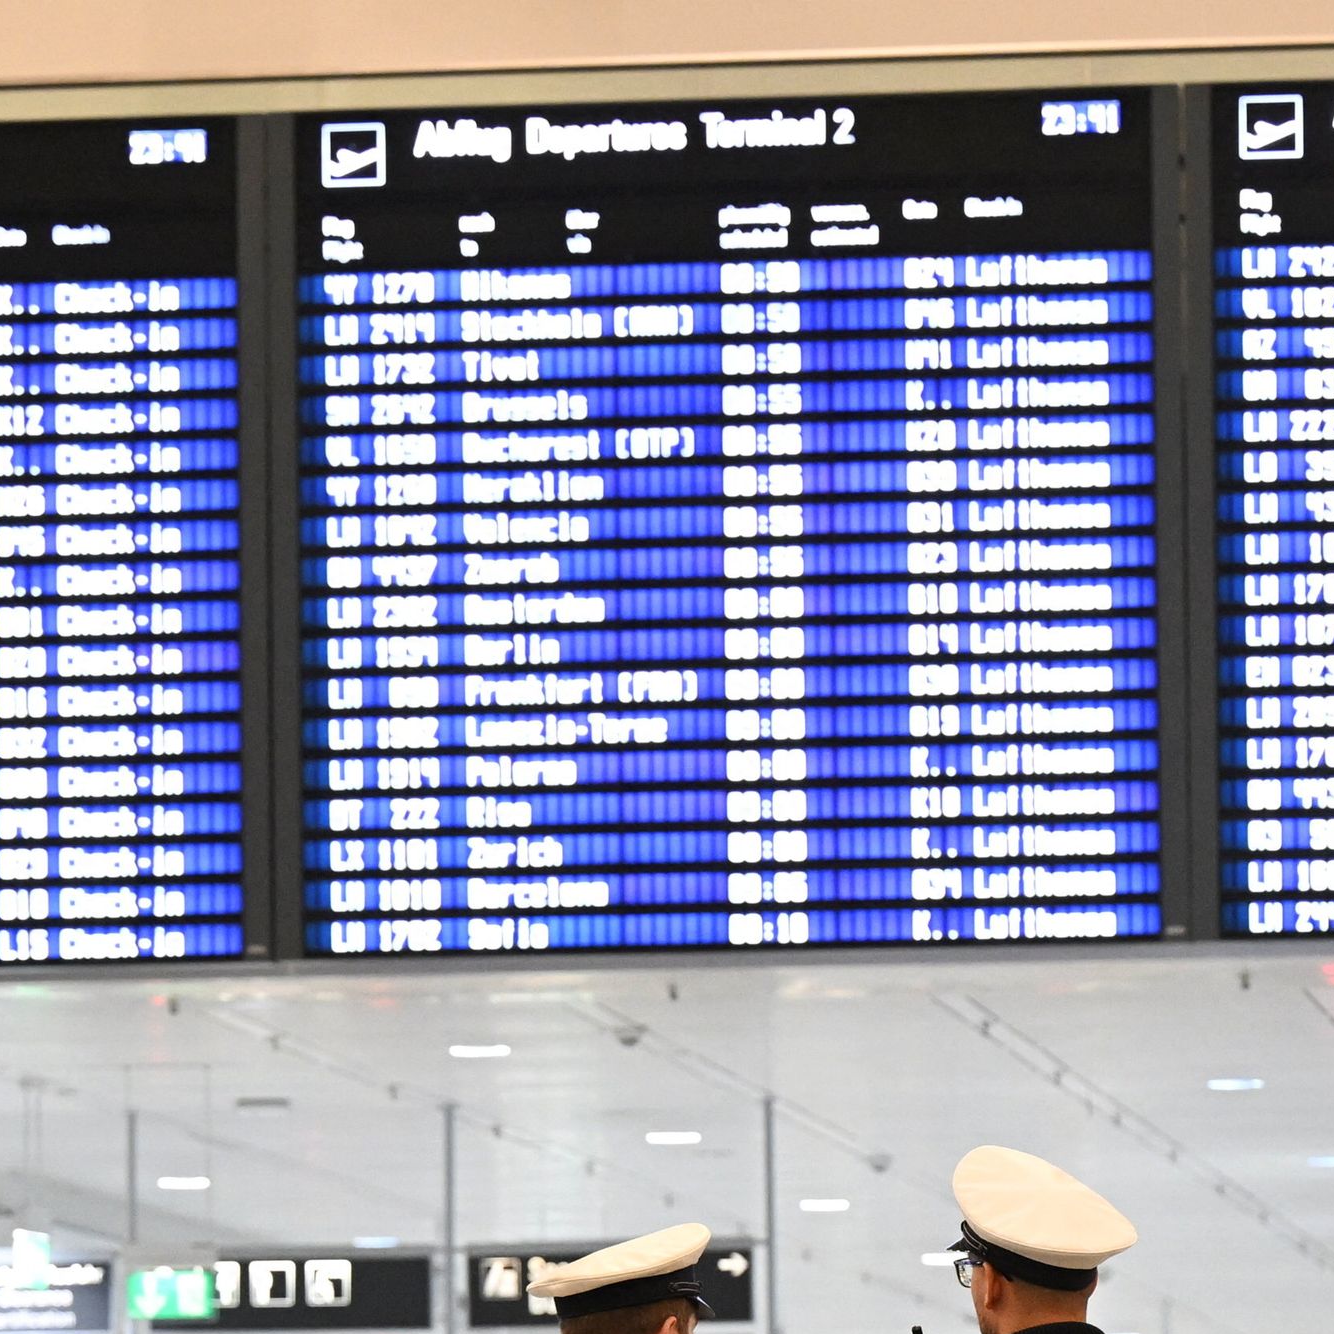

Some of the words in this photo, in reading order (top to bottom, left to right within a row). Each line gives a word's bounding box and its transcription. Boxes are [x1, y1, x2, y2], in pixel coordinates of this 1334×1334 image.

[129, 131, 205, 164] 23:41
[413, 119, 511, 162] Abflug
[526, 117, 687, 160] Departures
[700, 109, 826, 148] Terminal
[833, 108, 855, 144] 2
[1042, 103, 1118, 135] 23:41
[966, 296, 1108, 327] Lufthansa
[56, 483, 181, 515] Check-in
[58, 765, 183, 798] Check-in
[973, 785, 1115, 816] Lufthansa
[973, 826, 1115, 857] Lufthansa
